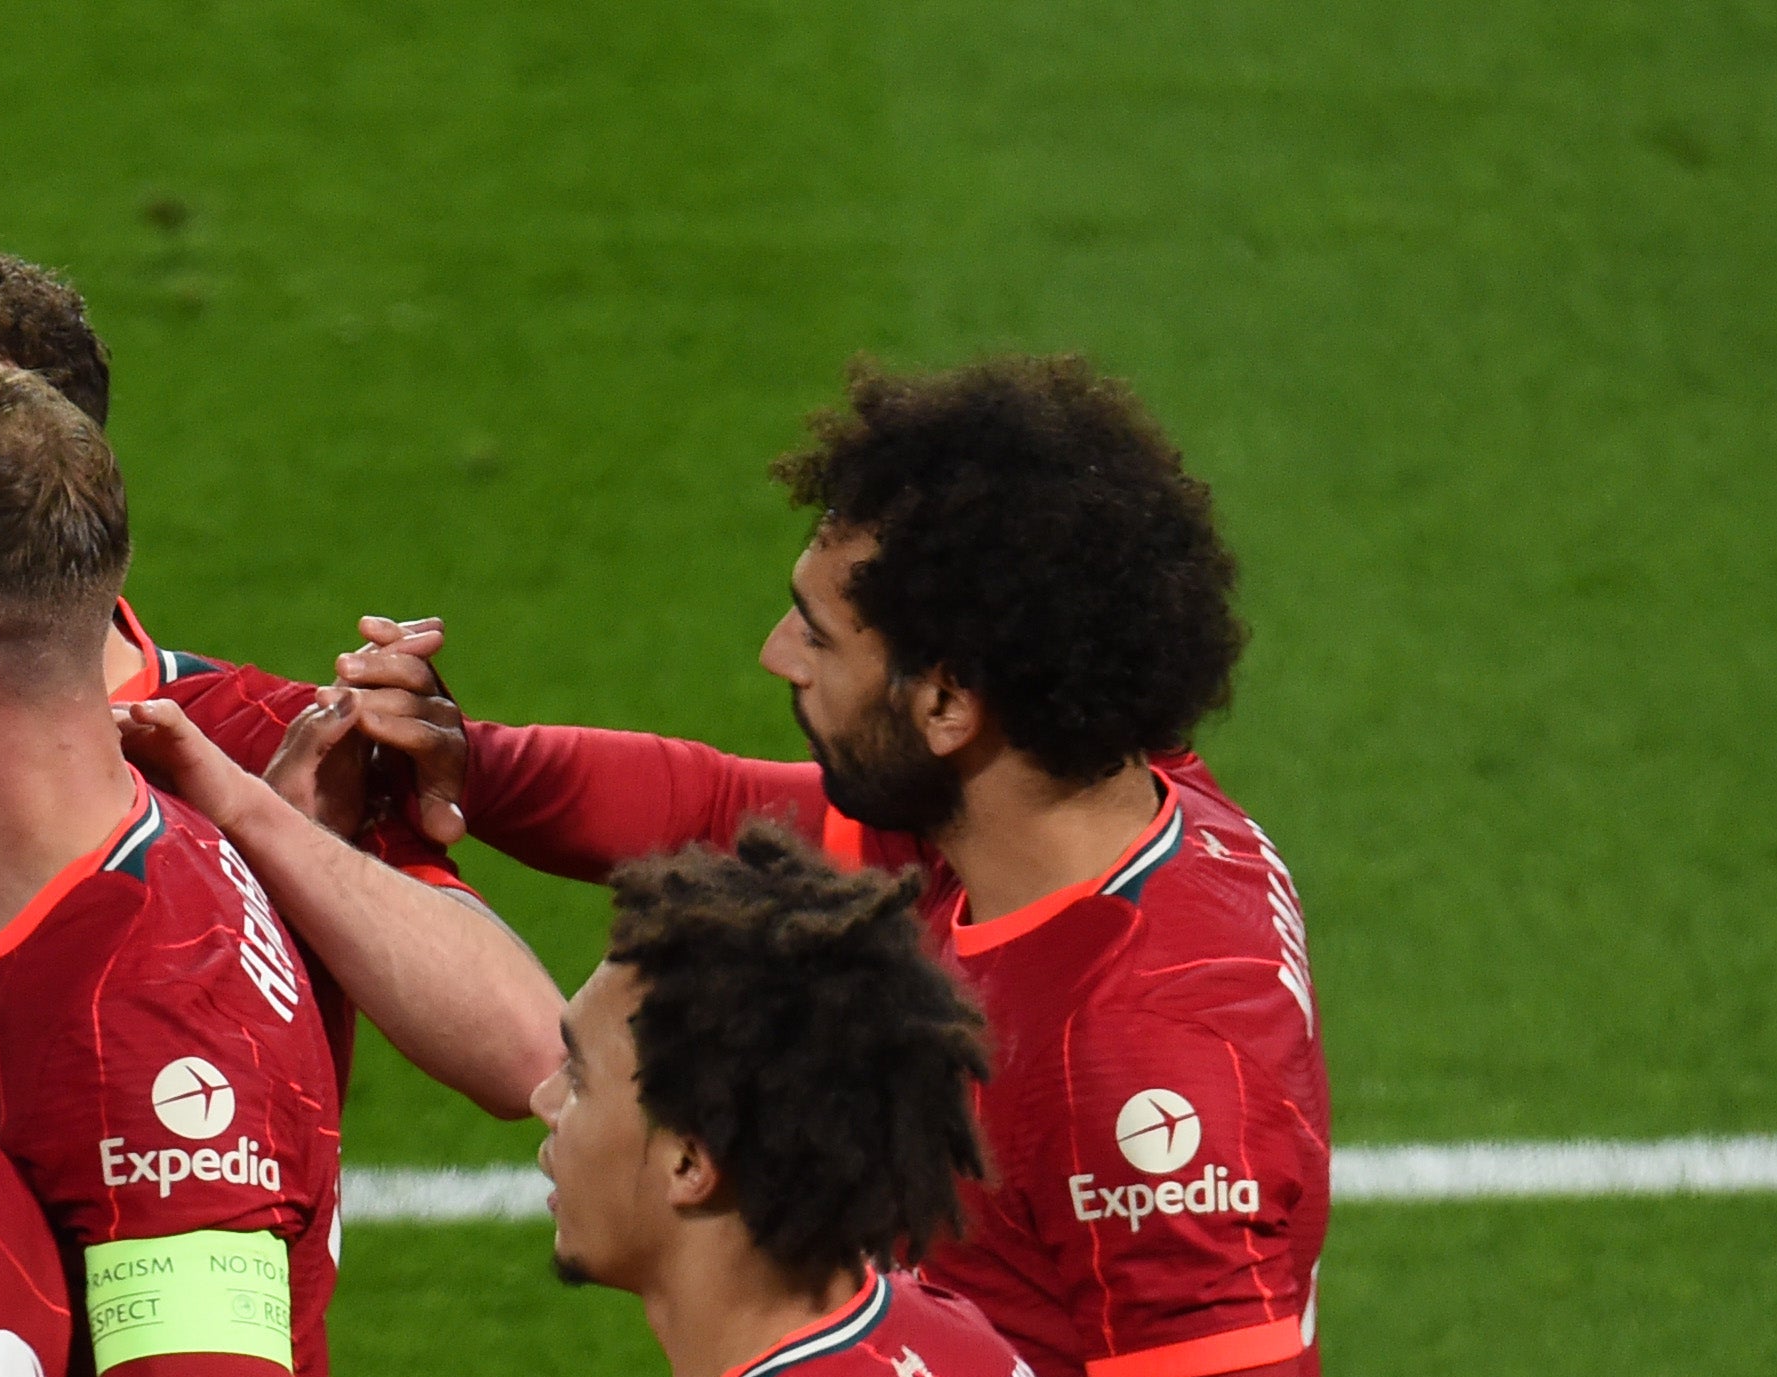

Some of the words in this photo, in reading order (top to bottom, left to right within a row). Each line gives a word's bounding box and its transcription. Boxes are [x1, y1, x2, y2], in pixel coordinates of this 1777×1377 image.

[99, 1136, 280, 1199] Expedia
[1068, 1163, 1259, 1233] Expedia
[210, 1255, 247, 1273] NO
[253, 1258, 276, 1280] TO
